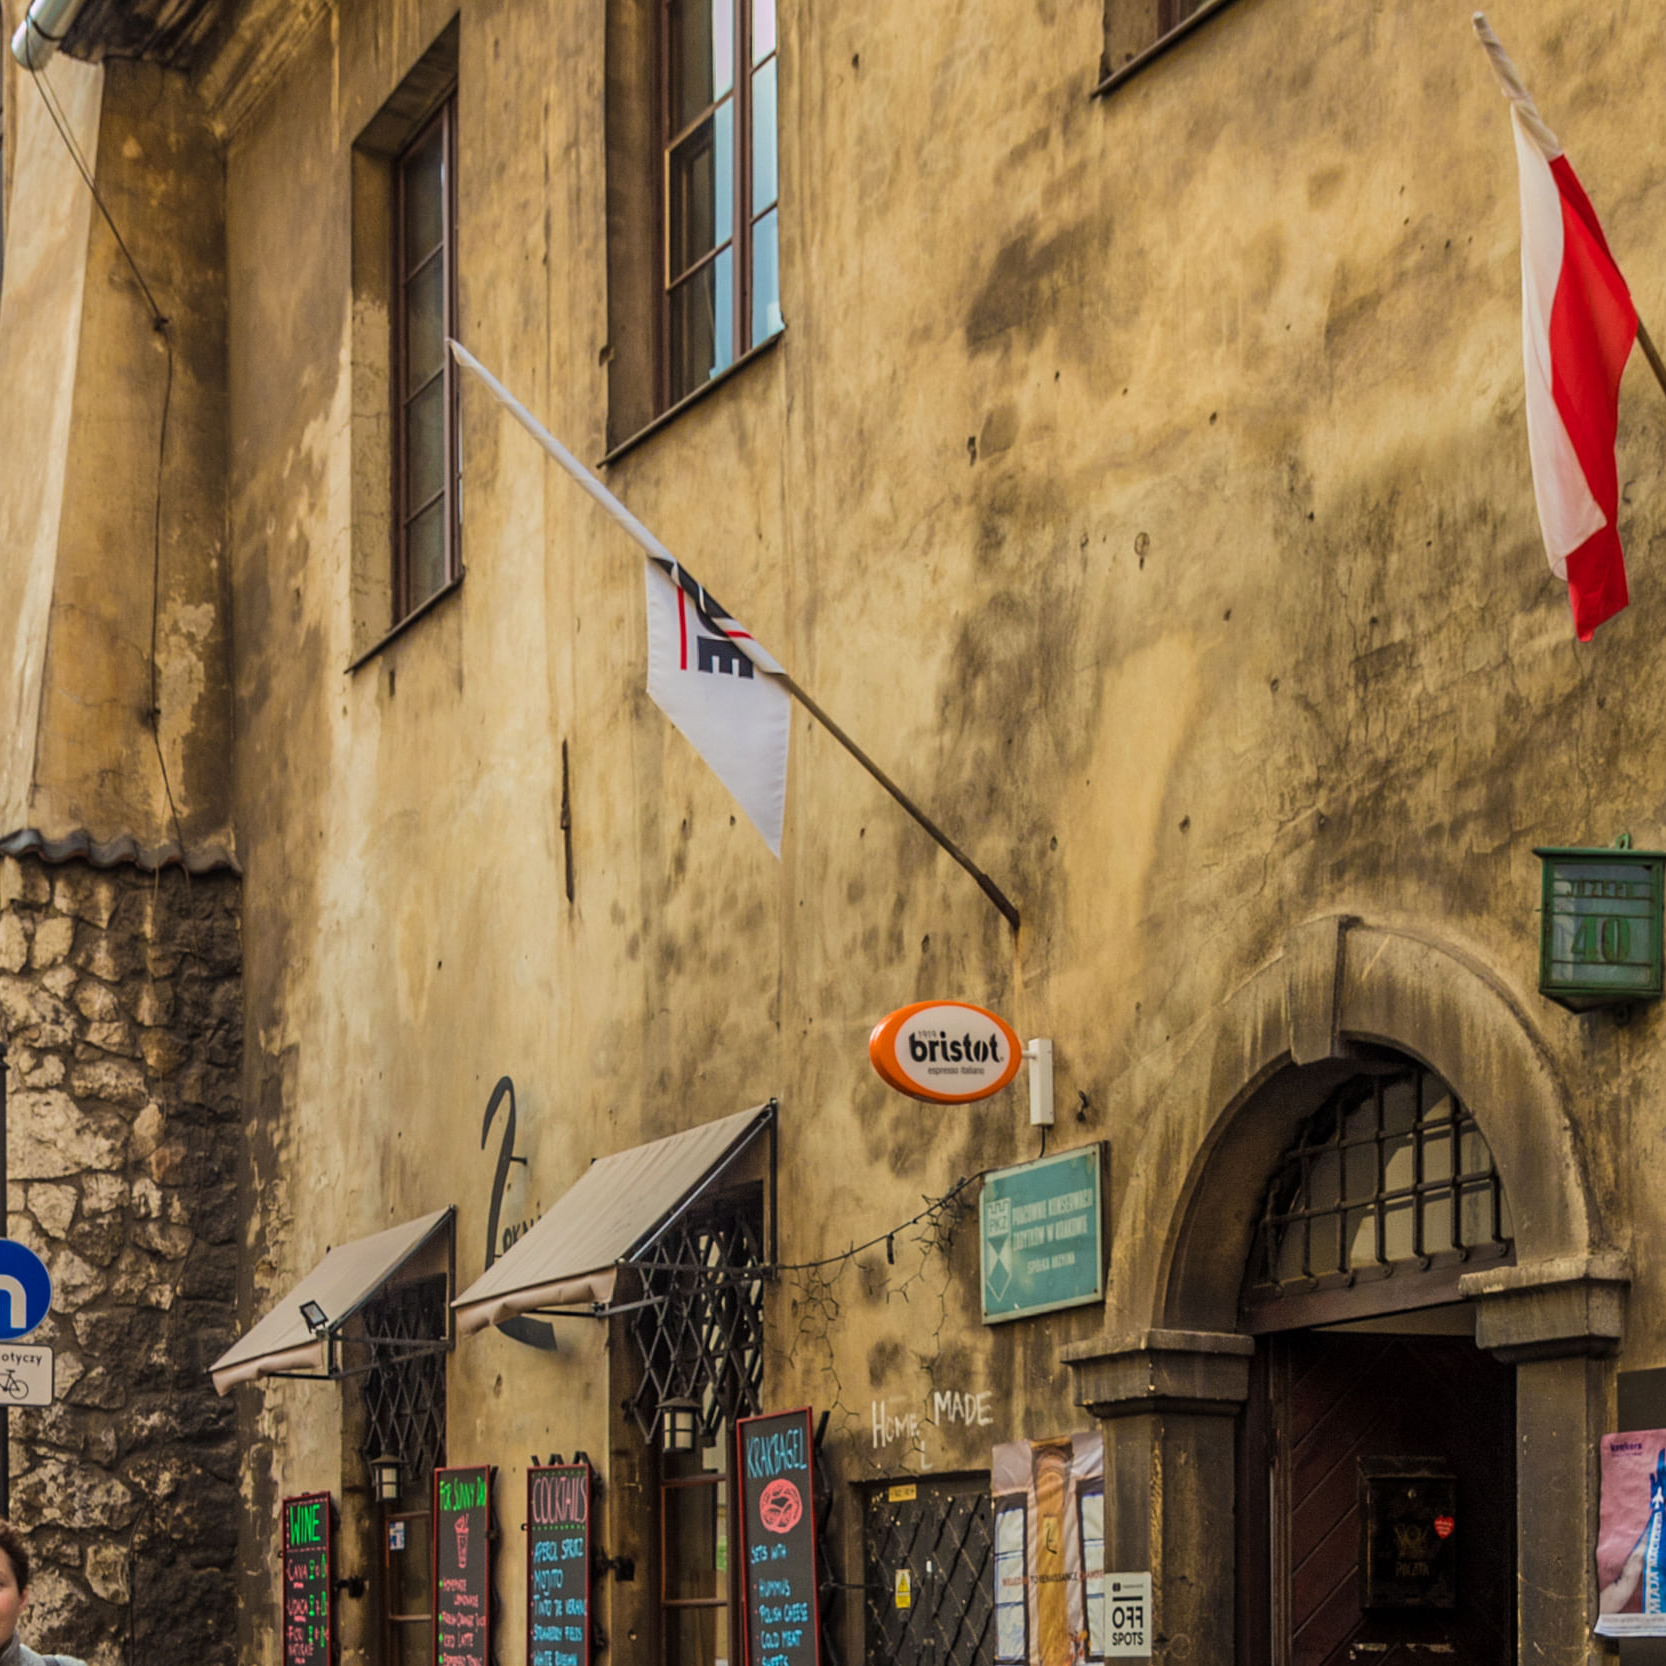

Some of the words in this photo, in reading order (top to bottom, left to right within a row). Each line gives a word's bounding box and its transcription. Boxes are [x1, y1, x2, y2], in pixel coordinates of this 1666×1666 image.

[1571, 917, 1631, 961] 40
[909, 1031, 1001, 1063] bristot
[928, 1067, 959, 1075] espresso
[872, 1400, 920, 1449] HOME
[933, 1389, 994, 1427] MADE
[533, 1476, 587, 1524] COCKTAILS
[289, 1503, 321, 1545] WINE
[534, 1568, 564, 1597] MOJITO
[1112, 1632, 1144, 1646] SPOTS
